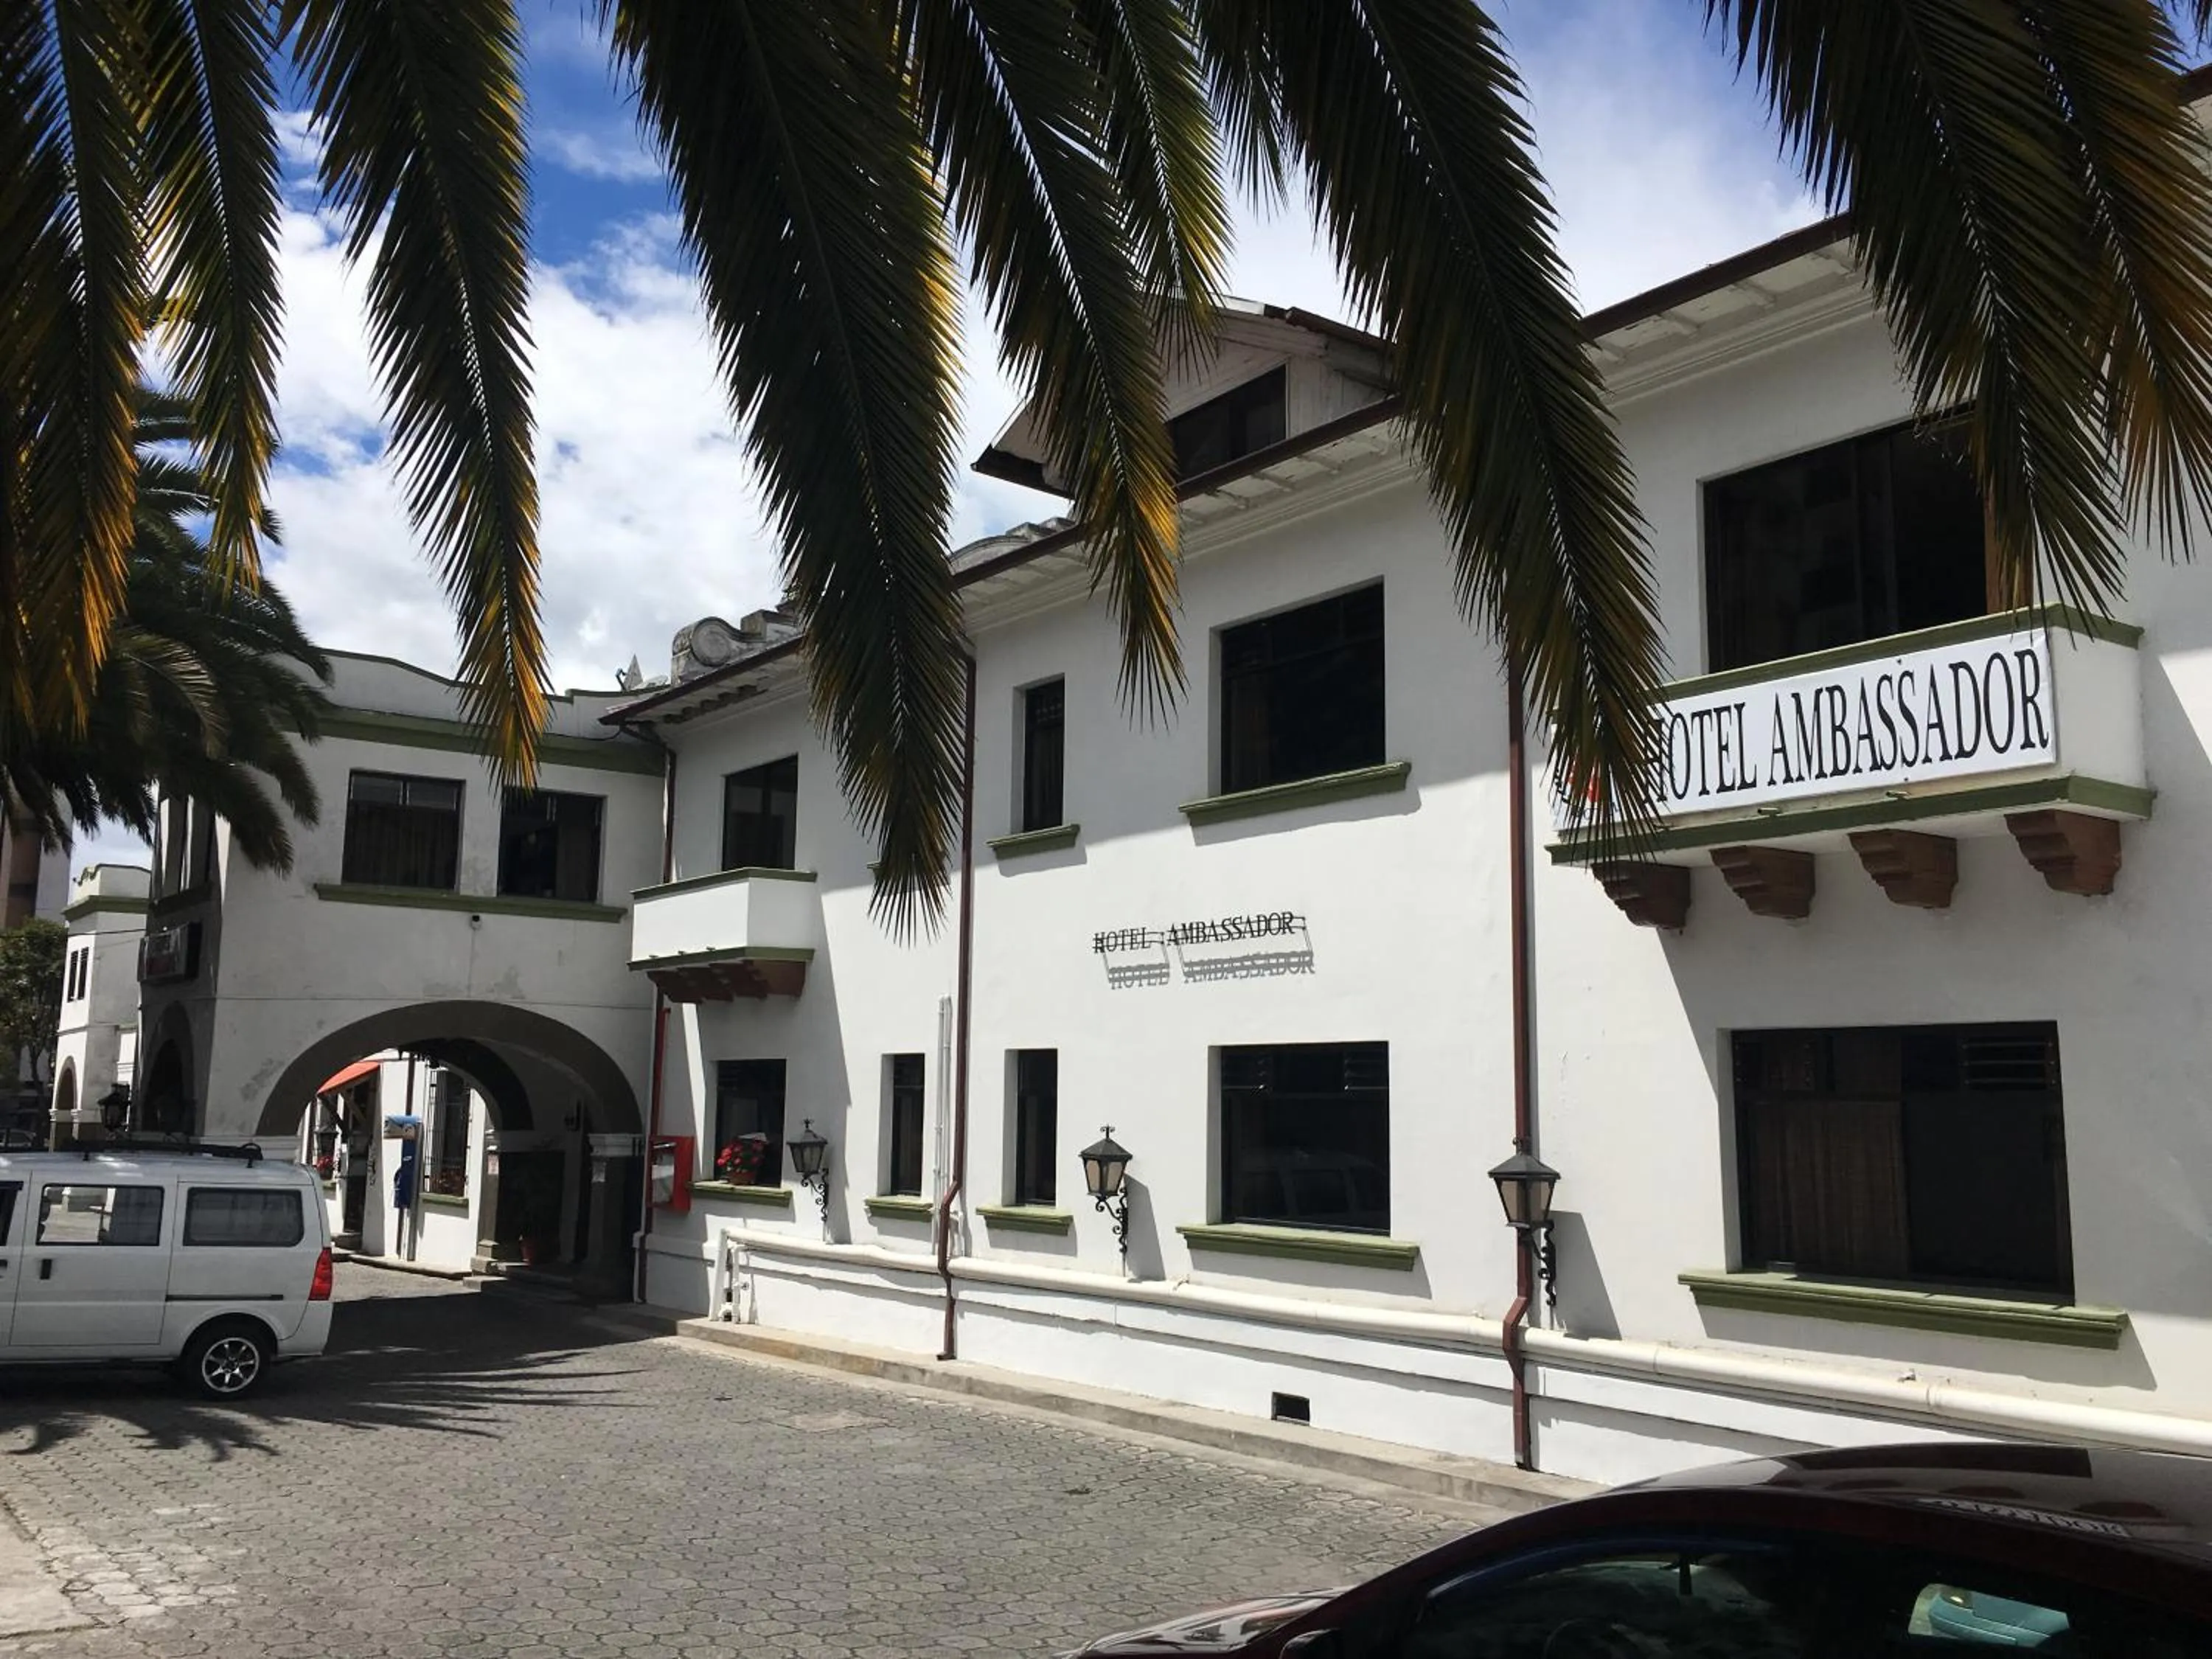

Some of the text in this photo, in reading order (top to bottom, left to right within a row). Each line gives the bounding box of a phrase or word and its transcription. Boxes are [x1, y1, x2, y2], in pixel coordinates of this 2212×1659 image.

[1767, 648, 2049, 787] AMBASSADOR
[1093, 911, 1295, 953] HOTEL AMBASSADOR
